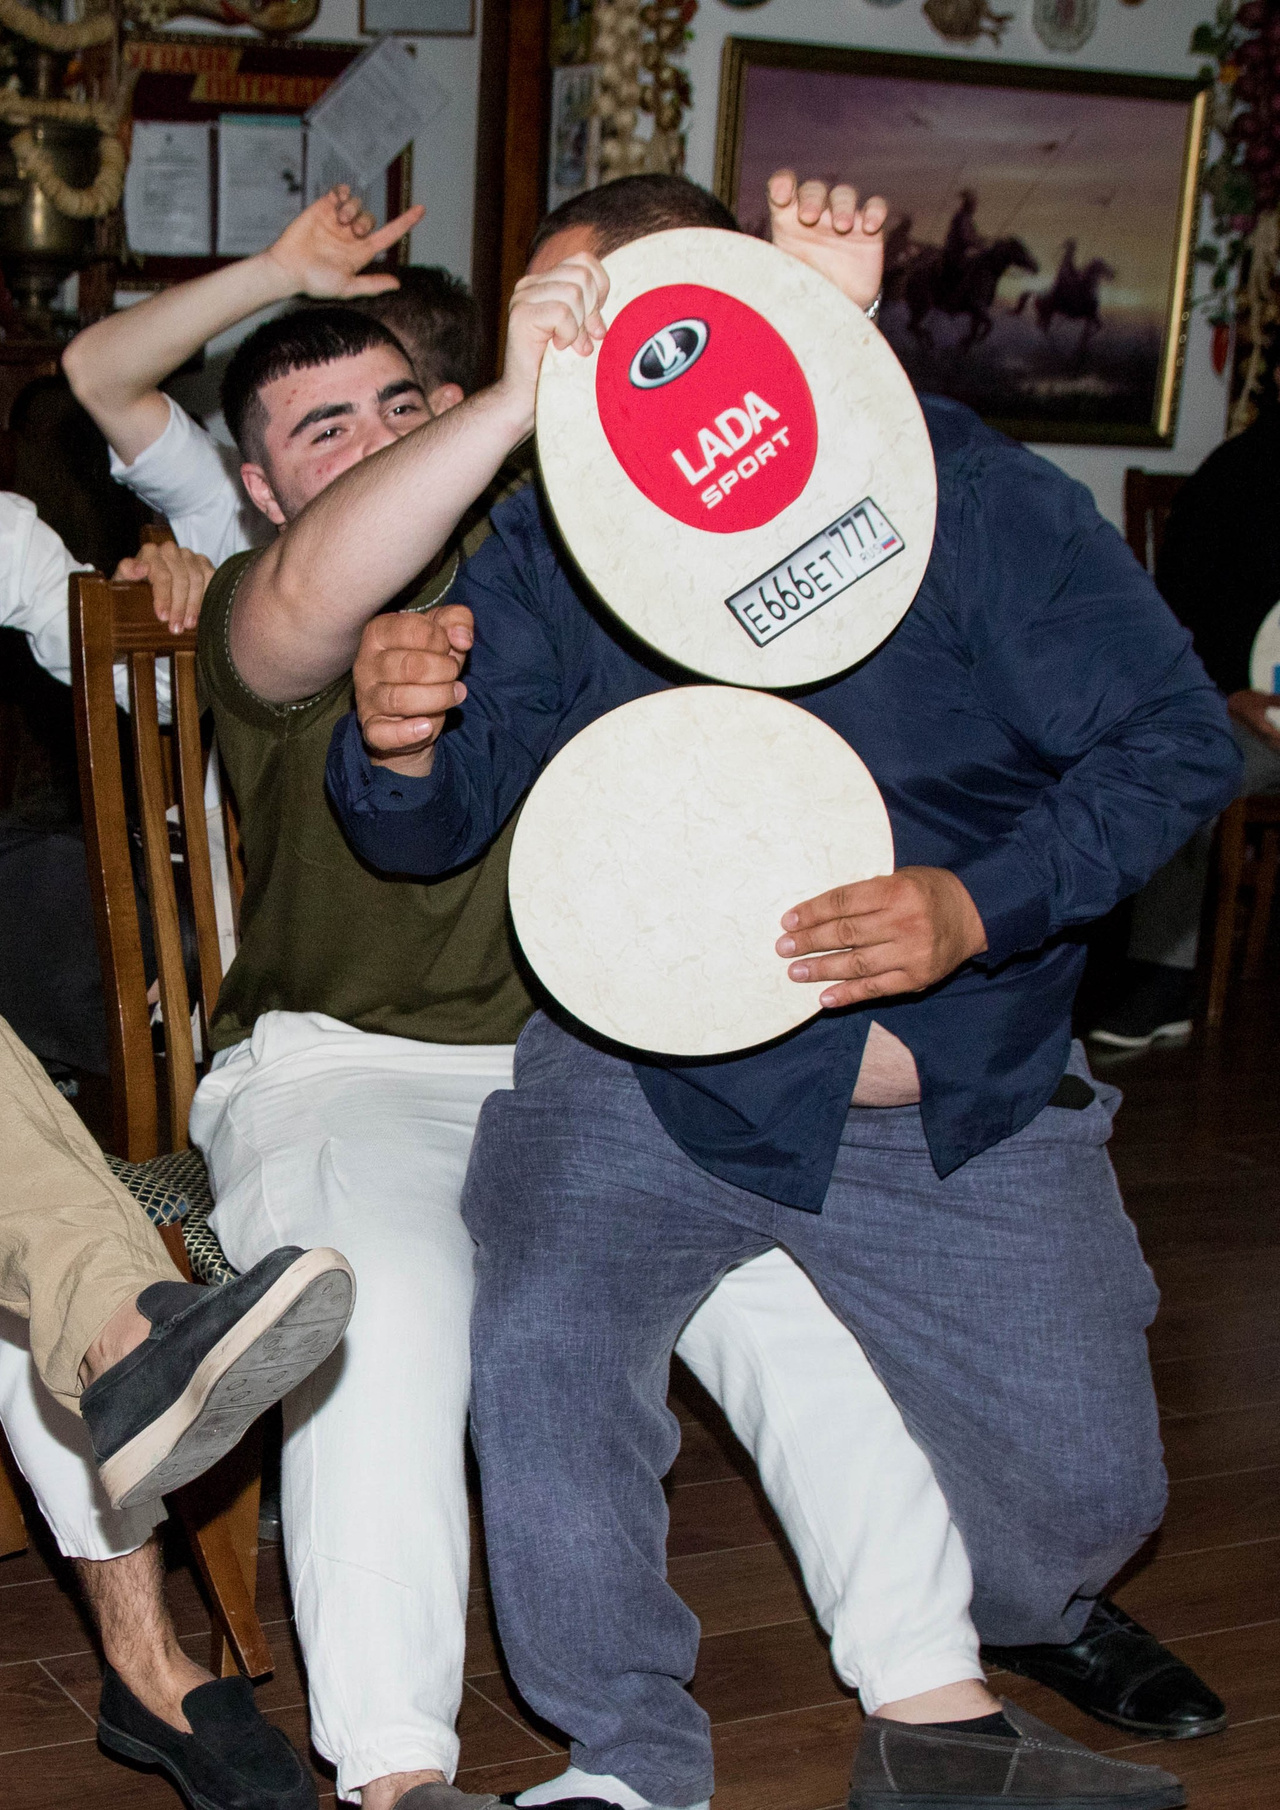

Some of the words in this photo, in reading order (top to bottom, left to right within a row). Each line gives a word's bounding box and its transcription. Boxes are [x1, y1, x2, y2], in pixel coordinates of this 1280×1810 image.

[672, 391, 780, 486] LADA
[700, 426, 790, 510] SPORT
[859, 543, 883, 562] RUS
